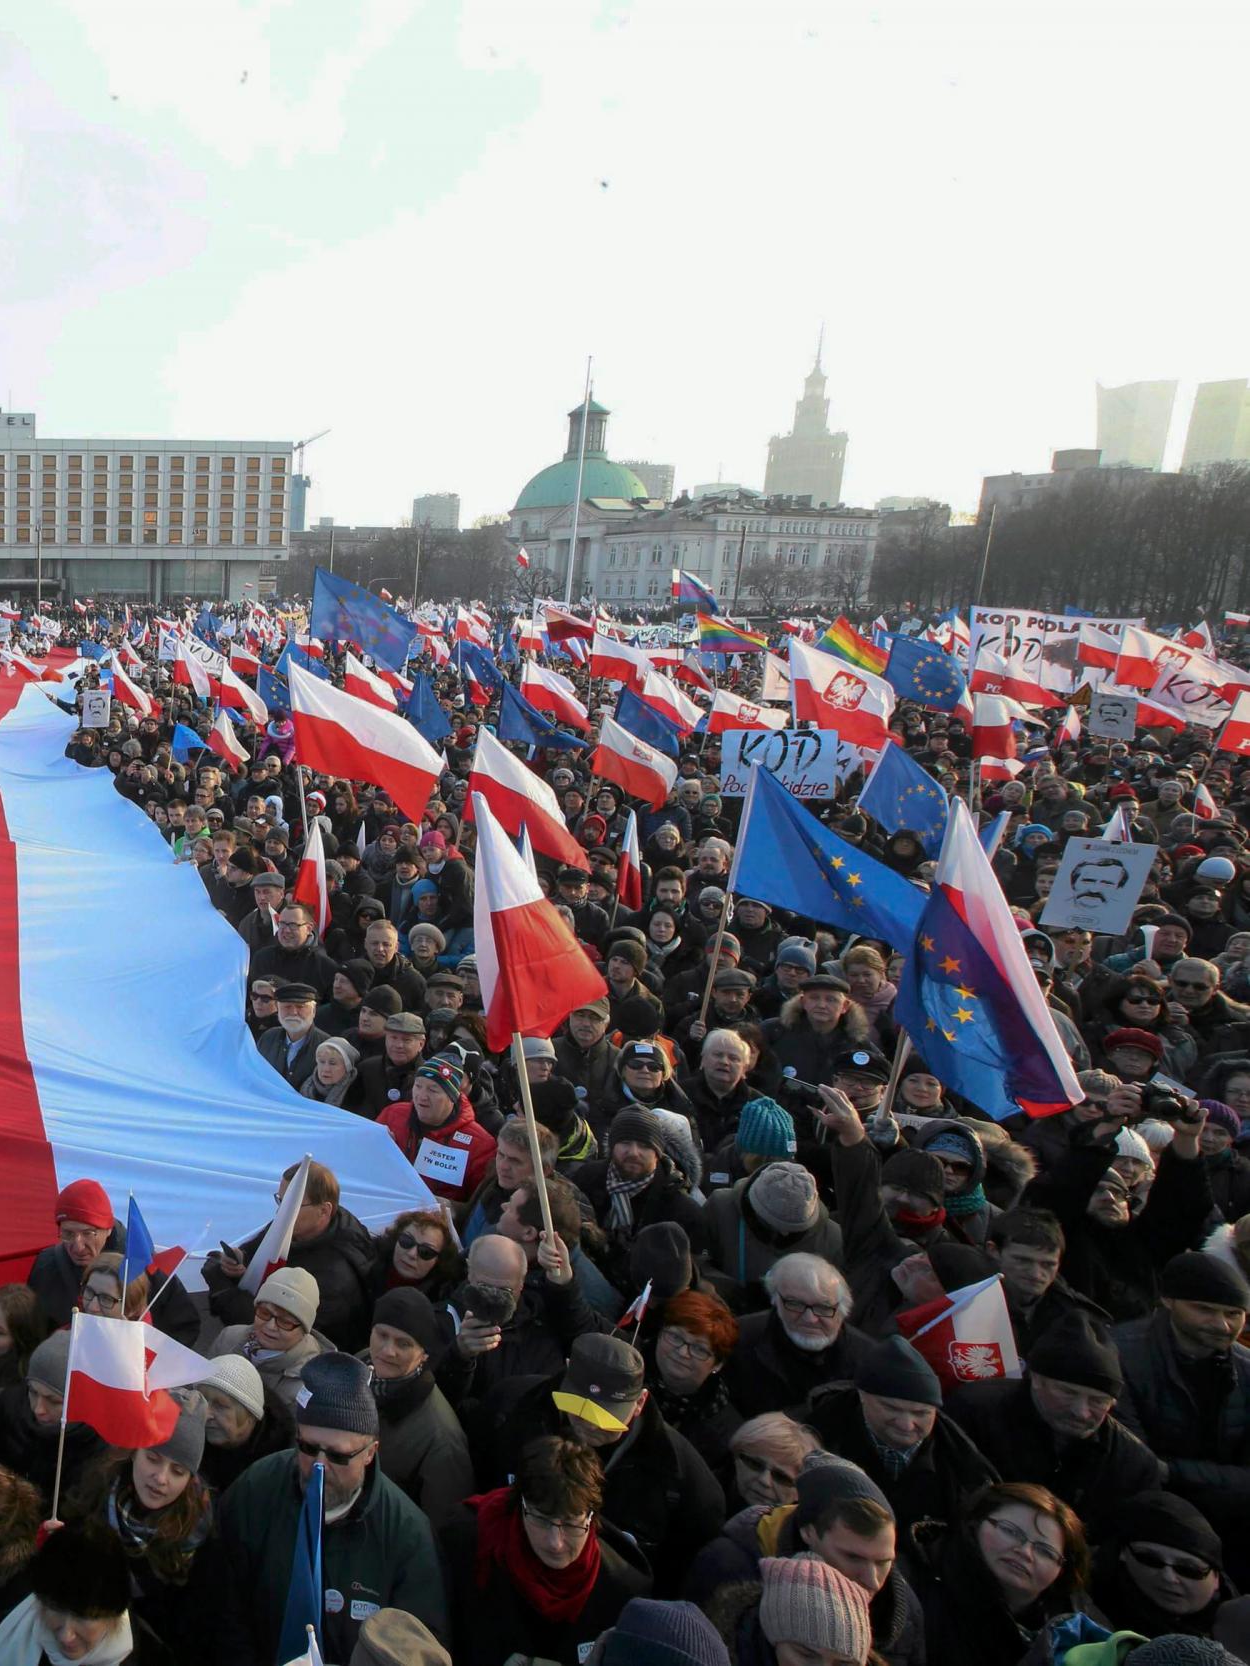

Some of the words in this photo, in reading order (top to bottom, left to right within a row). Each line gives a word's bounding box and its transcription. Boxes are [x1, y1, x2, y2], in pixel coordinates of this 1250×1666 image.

[975, 612, 1021, 627] KOD
[738, 730, 822, 775] KOD
[430, 1150, 456, 1161] JESTEM
[424, 1156, 433, 1164] TW
[434, 1161, 459, 1171] BOLEK
